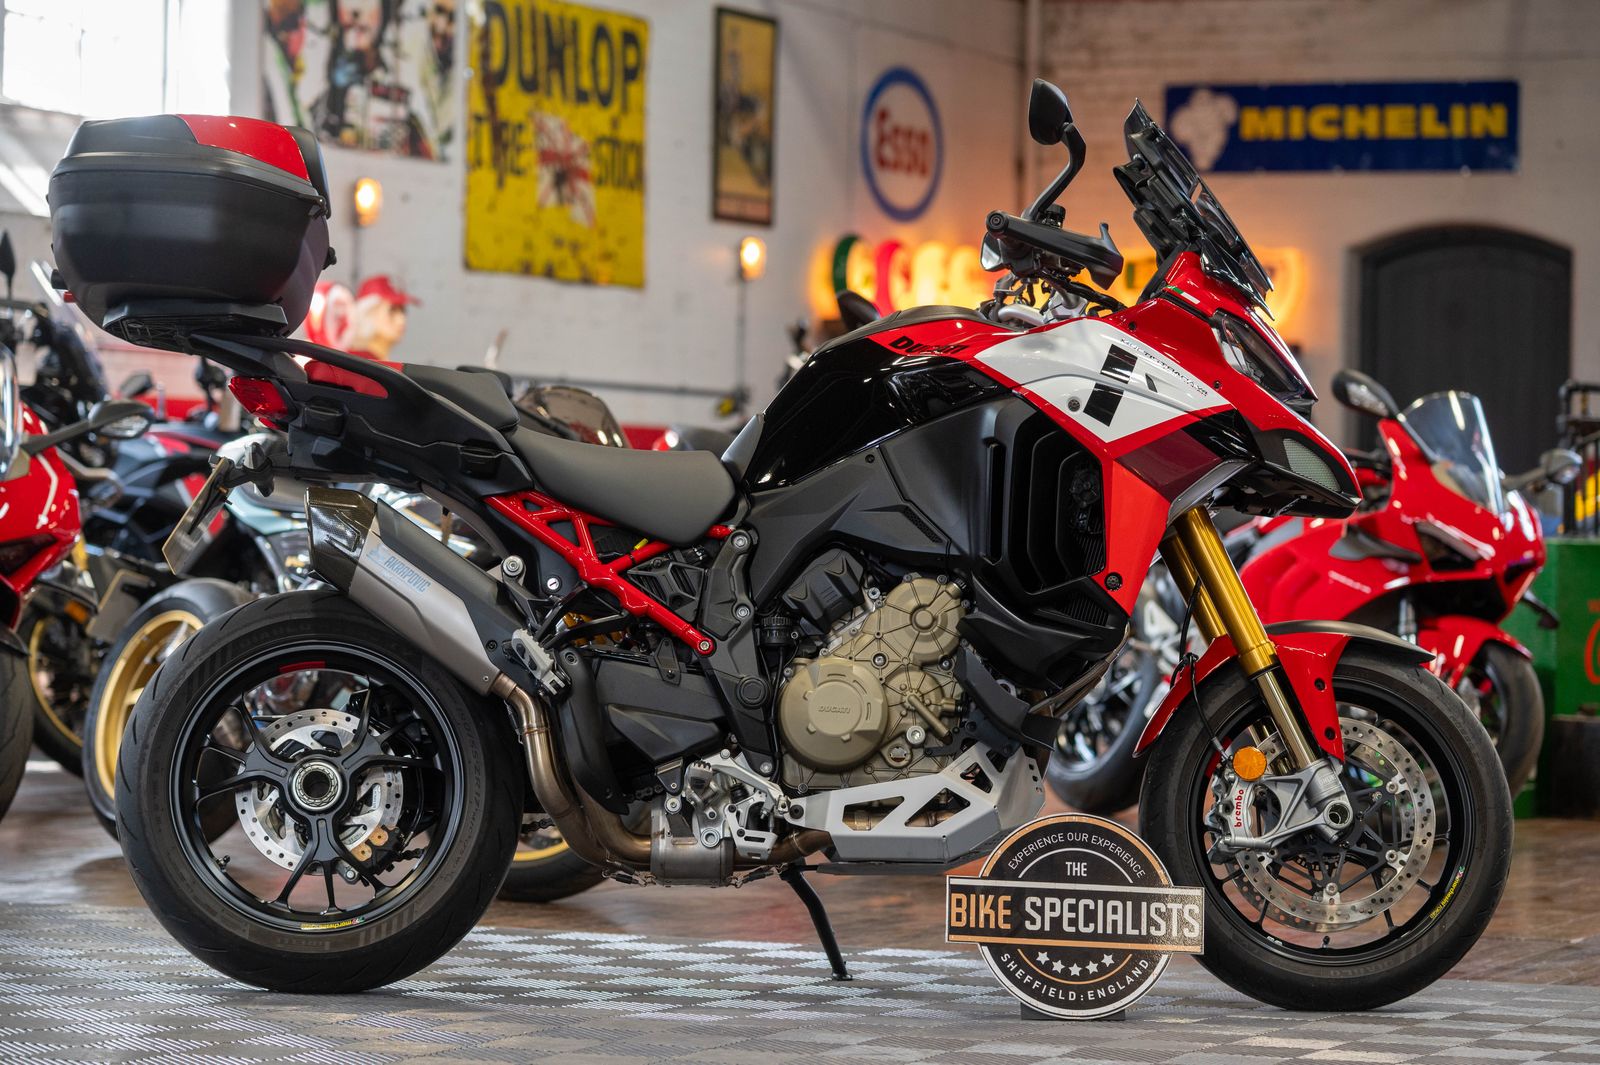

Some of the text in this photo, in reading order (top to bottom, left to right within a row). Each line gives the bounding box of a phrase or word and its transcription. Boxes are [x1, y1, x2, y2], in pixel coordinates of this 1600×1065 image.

[480, 0, 642, 116] DUNLOP
[1239, 103, 1508, 141] MICHELIN
[817, 704, 850, 714] DUCATI
[1234, 789, 1244, 827] brembo
[1008, 832, 1146, 879] EXPERIENCE OUR EXPERIENCE
[1065, 861, 1087, 877] THE
[950, 893, 1200, 938] BIKE SPECIALISTS
